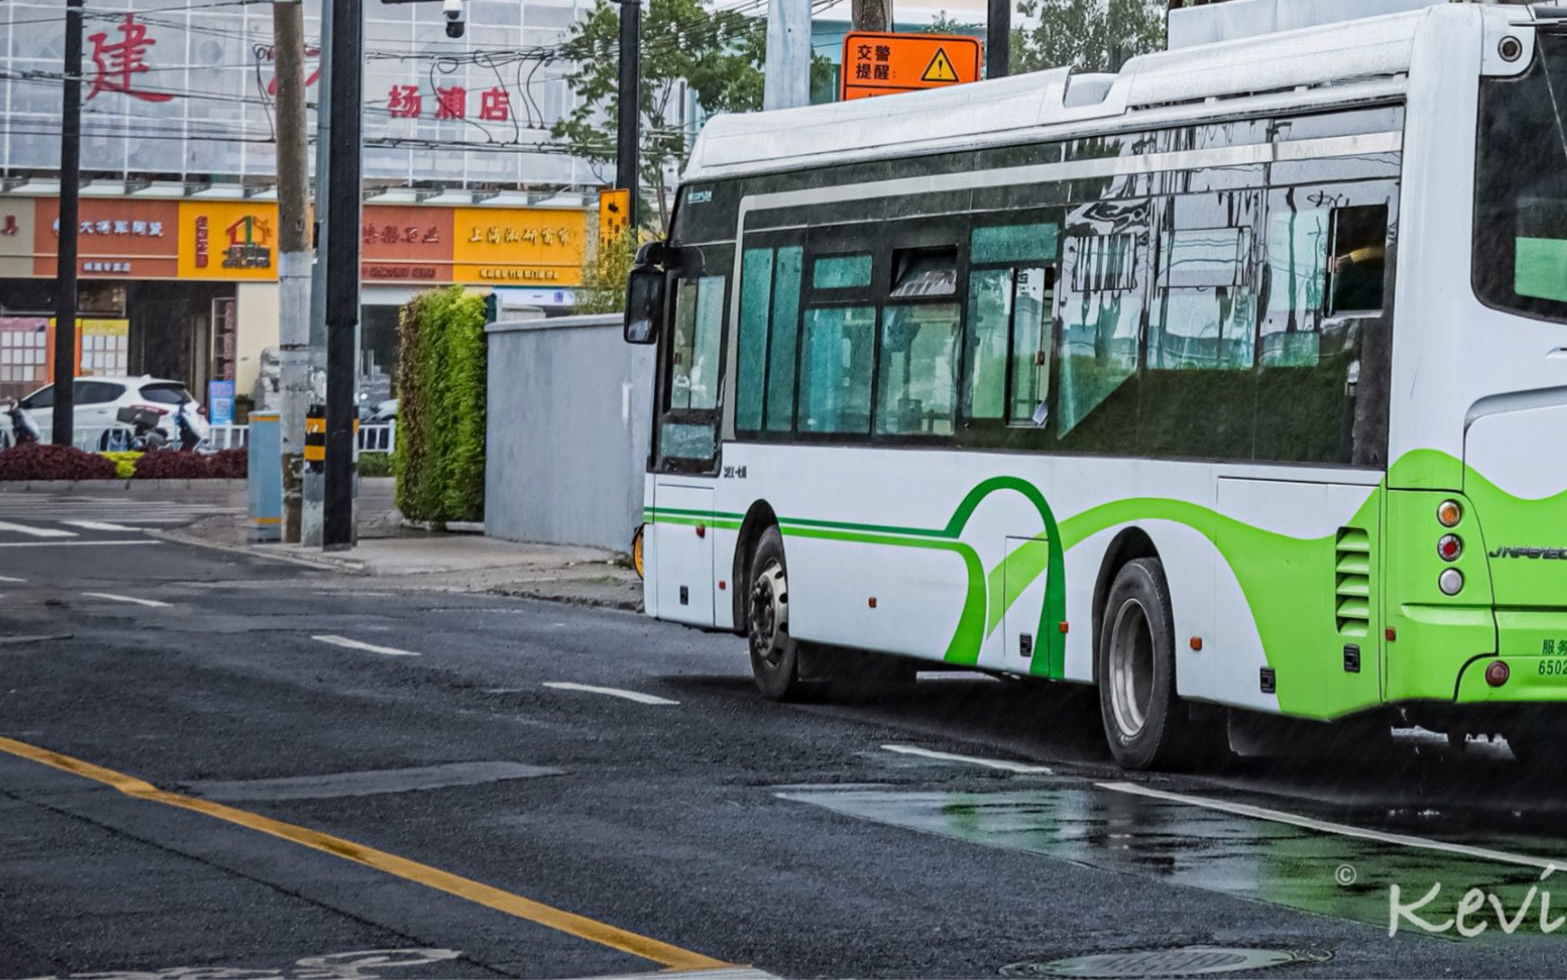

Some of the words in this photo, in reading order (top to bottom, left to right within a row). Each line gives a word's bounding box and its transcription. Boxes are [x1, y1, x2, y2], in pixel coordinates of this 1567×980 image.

[86, 12, 173, 103] 建
[857, 44, 891, 62] 交警
[388, 85, 509, 121] 杨浦店
